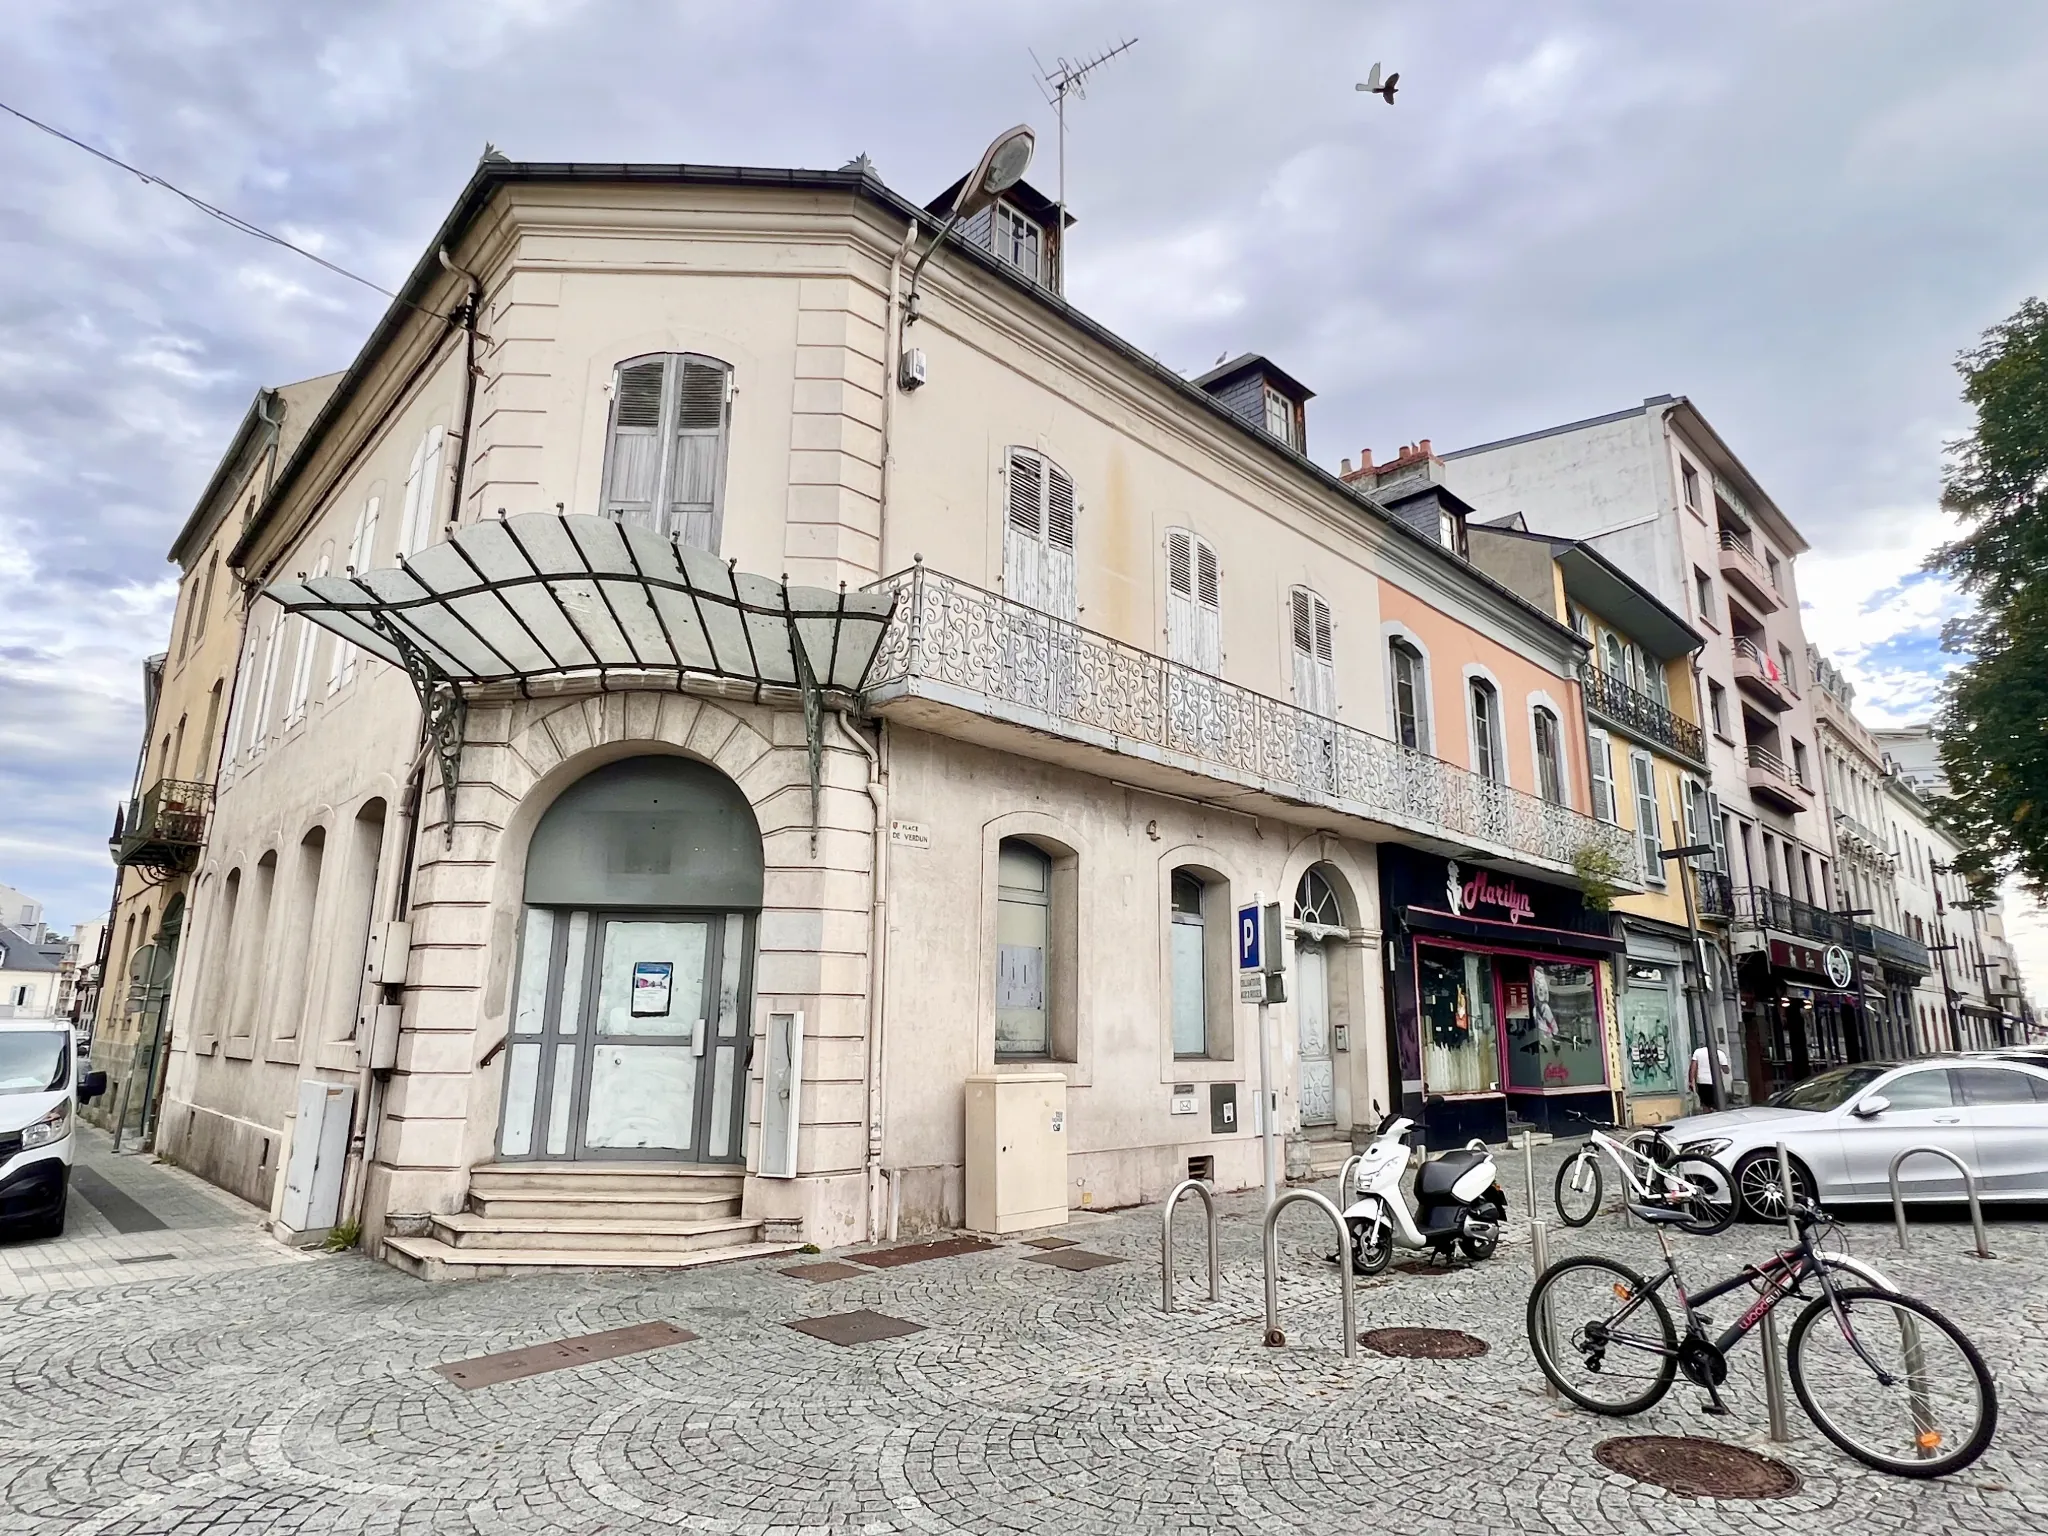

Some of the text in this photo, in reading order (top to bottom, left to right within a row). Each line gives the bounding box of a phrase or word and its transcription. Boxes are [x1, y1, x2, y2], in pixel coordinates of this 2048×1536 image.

[892, 832, 928, 843] DE VERDUN
[1463, 872, 1536, 926] Marilyn
[1243, 918, 1254, 959] P
